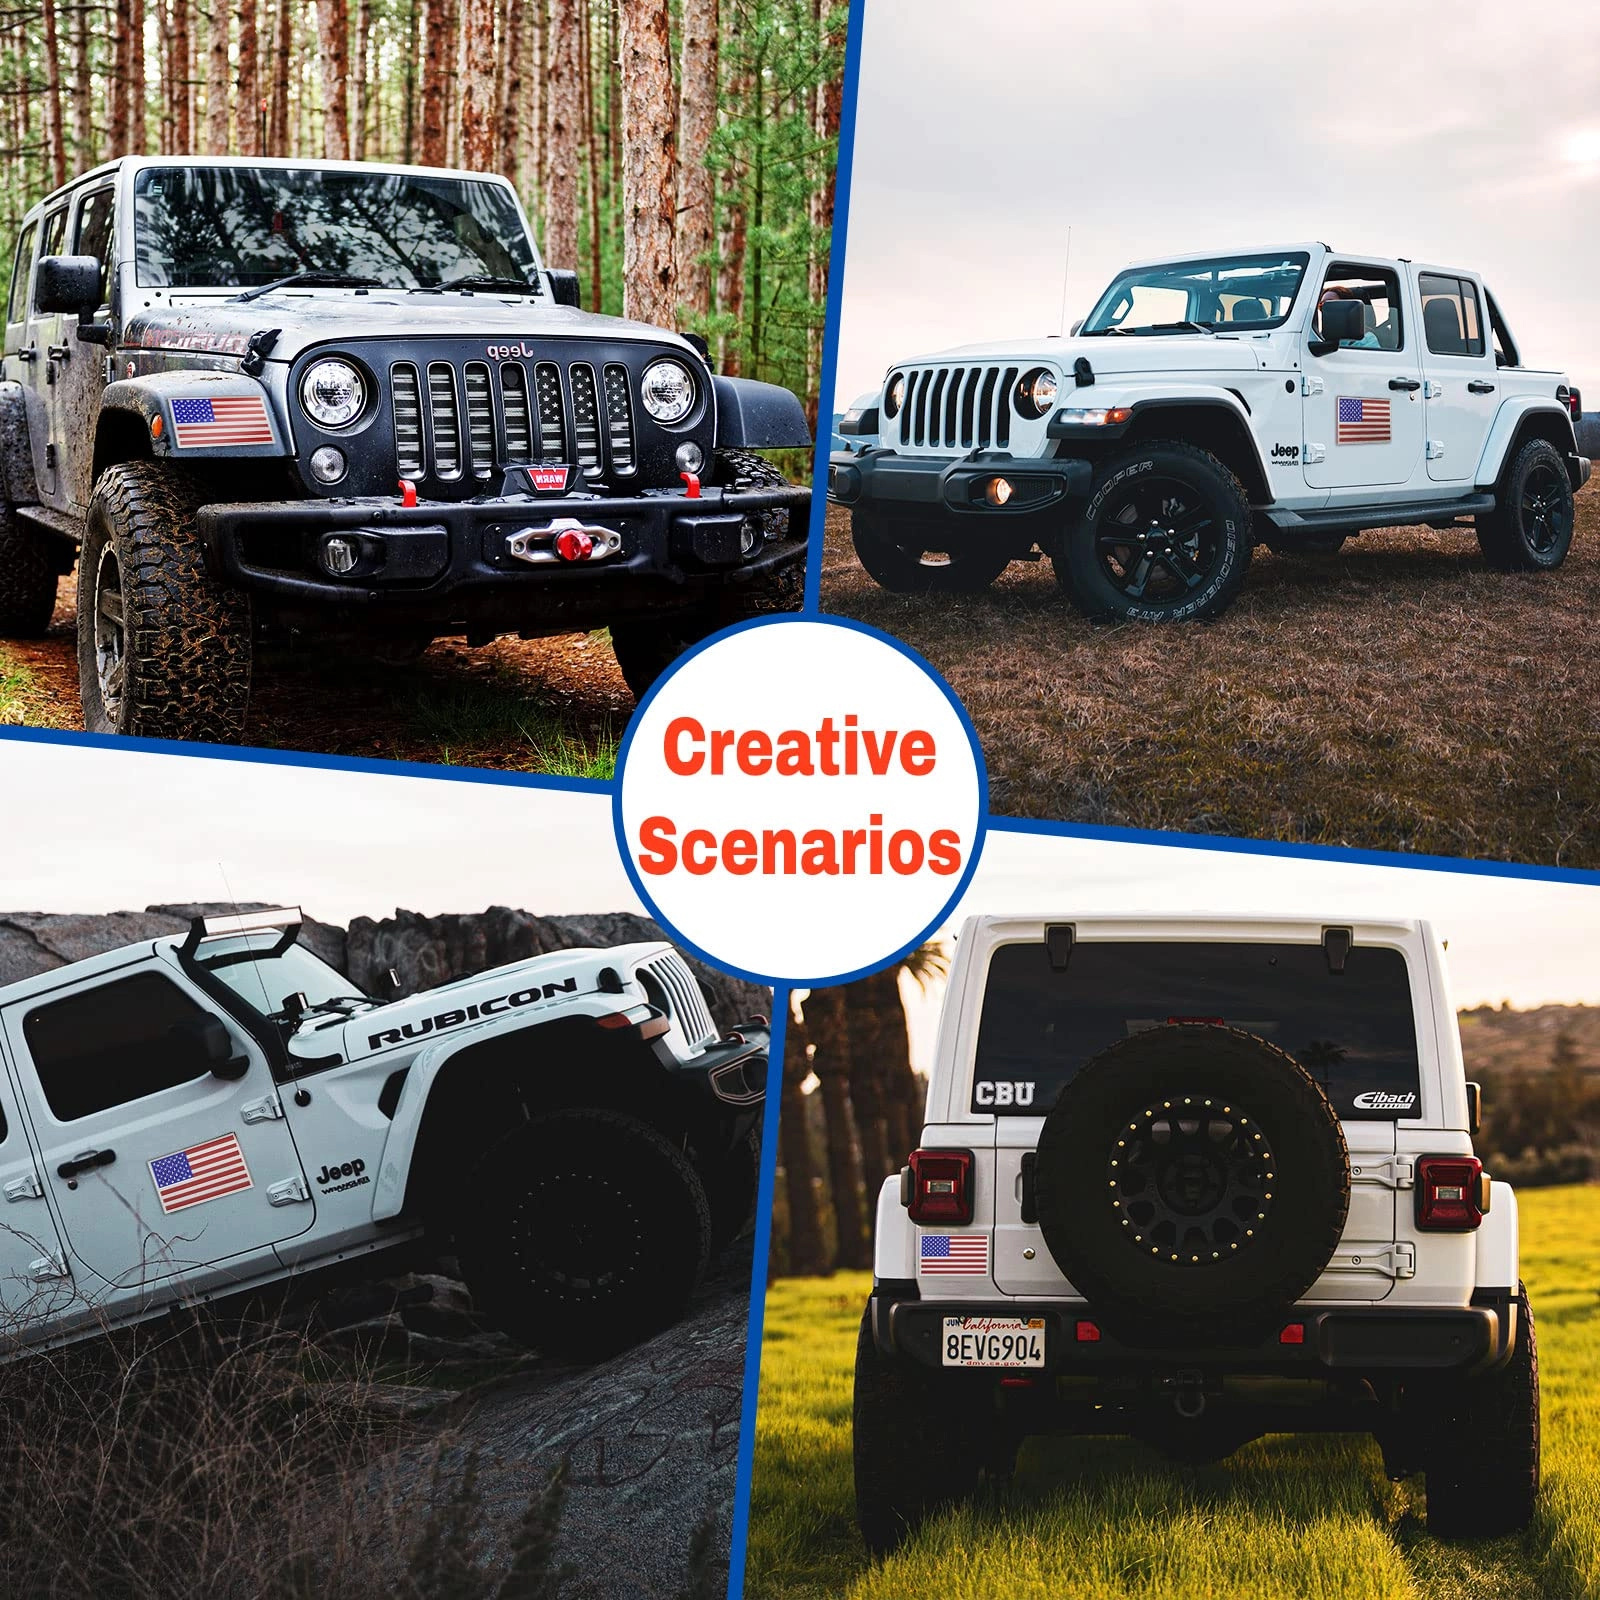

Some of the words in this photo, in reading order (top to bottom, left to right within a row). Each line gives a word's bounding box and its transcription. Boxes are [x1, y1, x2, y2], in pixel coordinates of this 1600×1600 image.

[1271, 443, 1299, 459] Jeep
[1086, 461, 1153, 520] COOPER
[1173, 519, 1236, 618] DISCOVERER
[368, 977, 578, 1050] RUBICON
[975, 1081, 1035, 1106] CBU
[1353, 1091, 1416, 1109] Eibach
[316, 1158, 365, 1184] Jeep
[962, 1317, 1028, 1333] California
[947, 1334, 1041, 1360] 8EVG904
